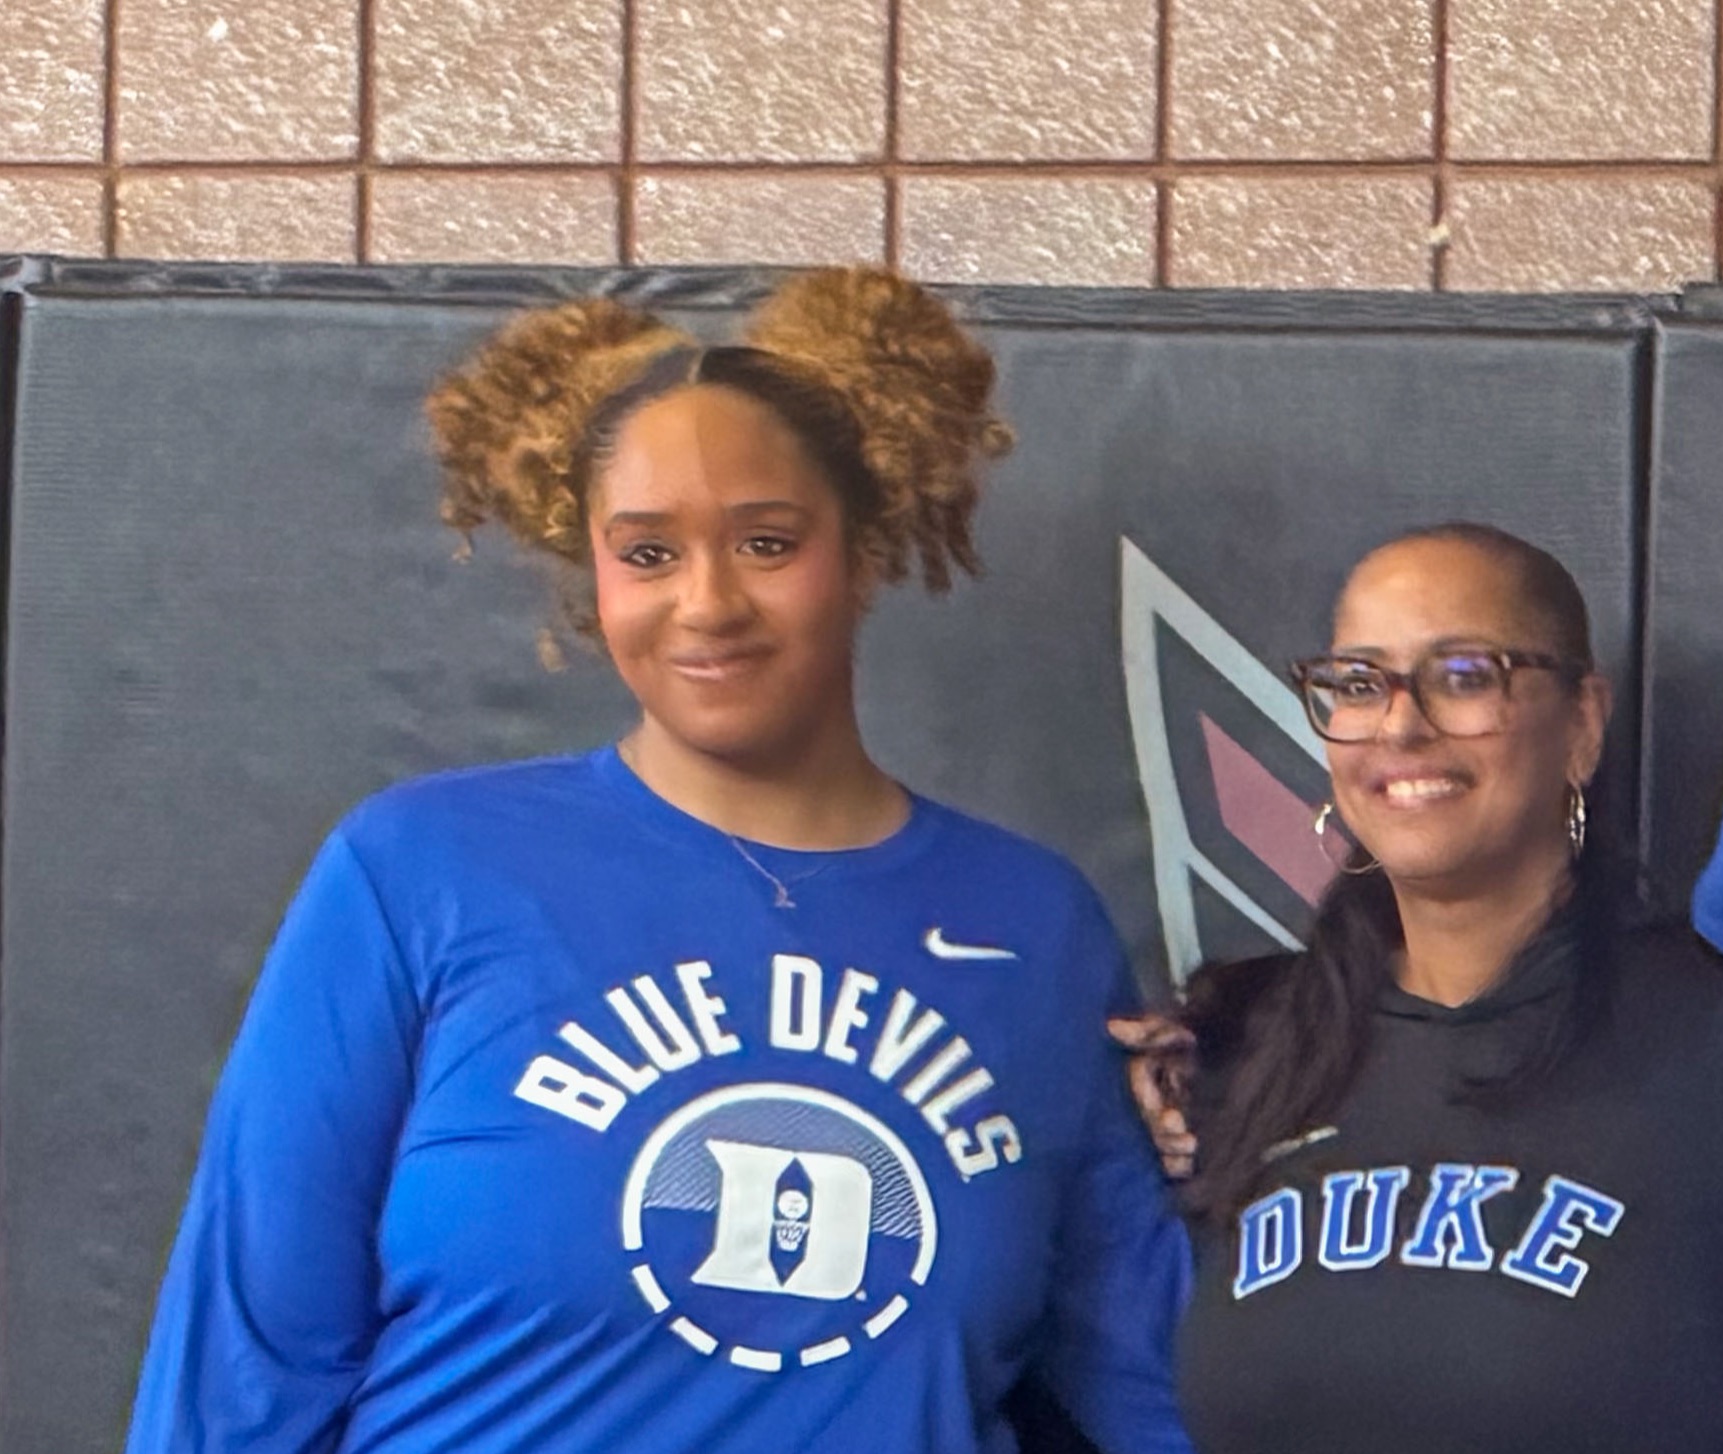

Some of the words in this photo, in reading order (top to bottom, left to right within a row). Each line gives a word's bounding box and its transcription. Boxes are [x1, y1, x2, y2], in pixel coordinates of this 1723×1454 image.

[512, 960, 741, 1133] BLUE
[770, 954, 1022, 1183] DEVILS
[1233, 1162, 1625, 1300] DUKE
